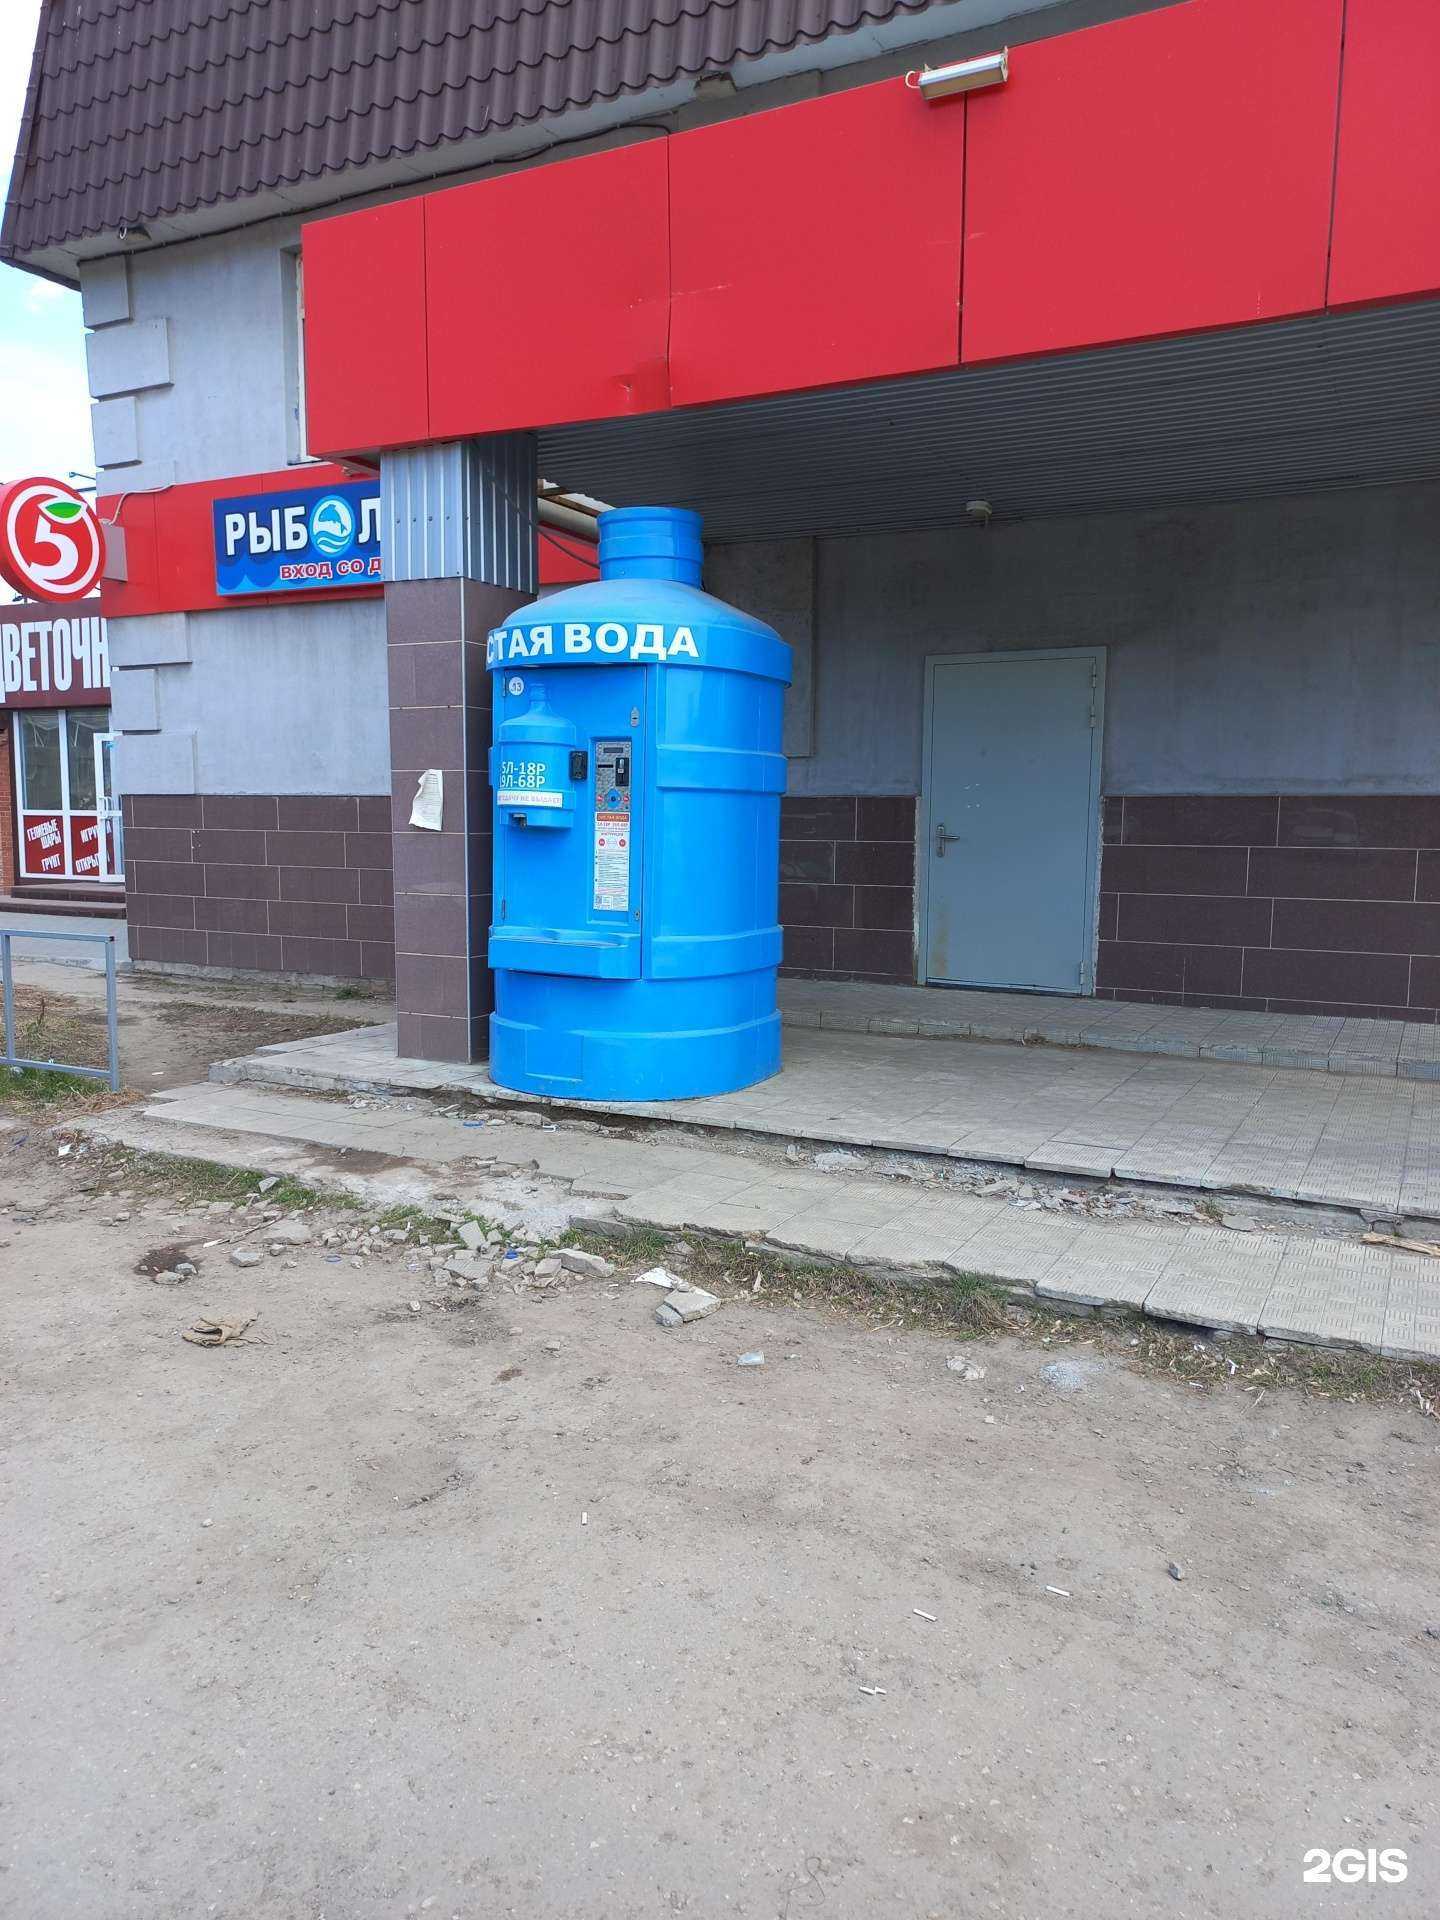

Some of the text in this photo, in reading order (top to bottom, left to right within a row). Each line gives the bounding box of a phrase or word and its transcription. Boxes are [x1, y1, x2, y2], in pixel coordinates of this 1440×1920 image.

[280, 562, 333, 581] ВХОД
[337, 559, 365, 575] СО
[0, 617, 111, 703] ВЕТОЧН
[564, 622, 700, 661] ВОДА
